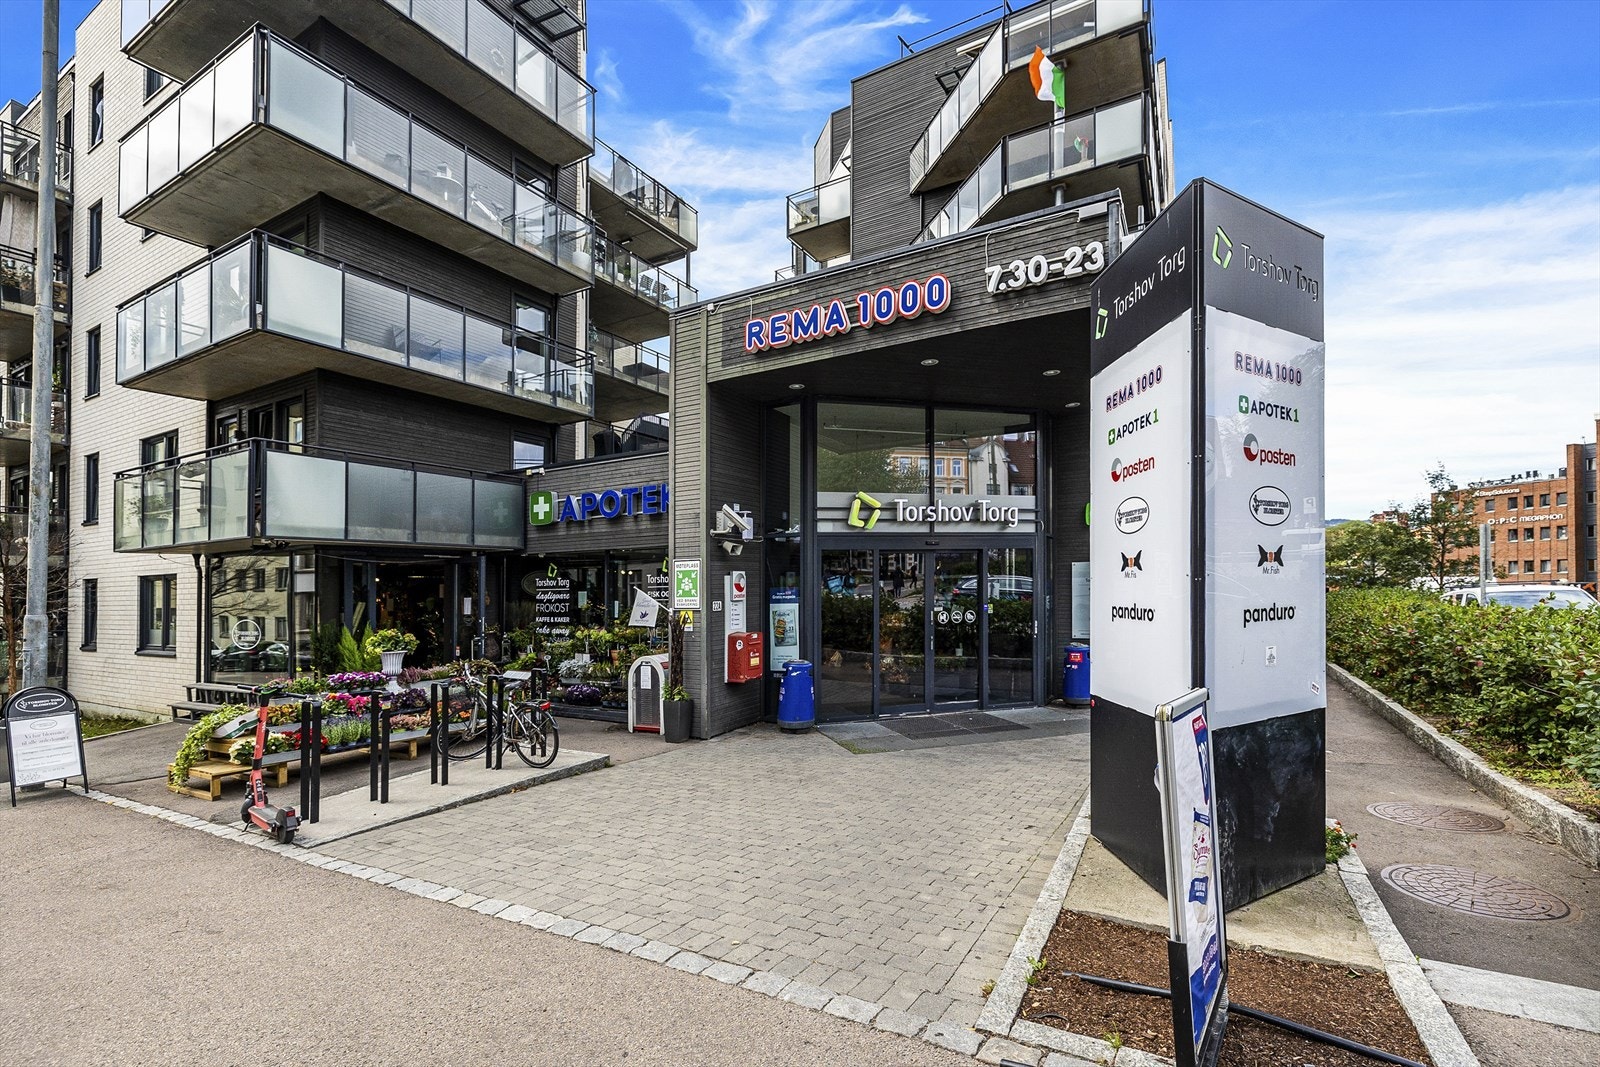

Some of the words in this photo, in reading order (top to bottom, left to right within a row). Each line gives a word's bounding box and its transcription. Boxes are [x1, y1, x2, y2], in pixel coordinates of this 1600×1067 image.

[1113, 273, 1155, 319] Torshov
[1158, 246, 1186, 281] Torg
[1241, 243, 1292, 284] Torshov
[1294, 265, 1319, 302] Torg
[745, 299, 850, 353] REMA
[856, 273, 952, 328] 1000
[1235, 351, 1273, 380] REMA
[1274, 362, 1303, 387] 1000
[1106, 382, 1135, 413] REMA
[1136, 365, 1163, 395] 1000
[1122, 456, 1155, 482] posten
[1260, 448, 1296, 467] posten
[894, 498, 974, 522] Torshov
[978, 500, 1019, 528] Torg
[535, 578, 557, 587] Torshov
[557, 577, 570, 588] Torg
[646, 574, 669, 584] Torsho
[536, 591, 570, 603] dagligvare
[536, 603, 570, 613] FROKOST
[1112, 603, 1154, 622] panduro
[1243, 602, 1296, 628] panduro
[551, 628, 570, 637] away
